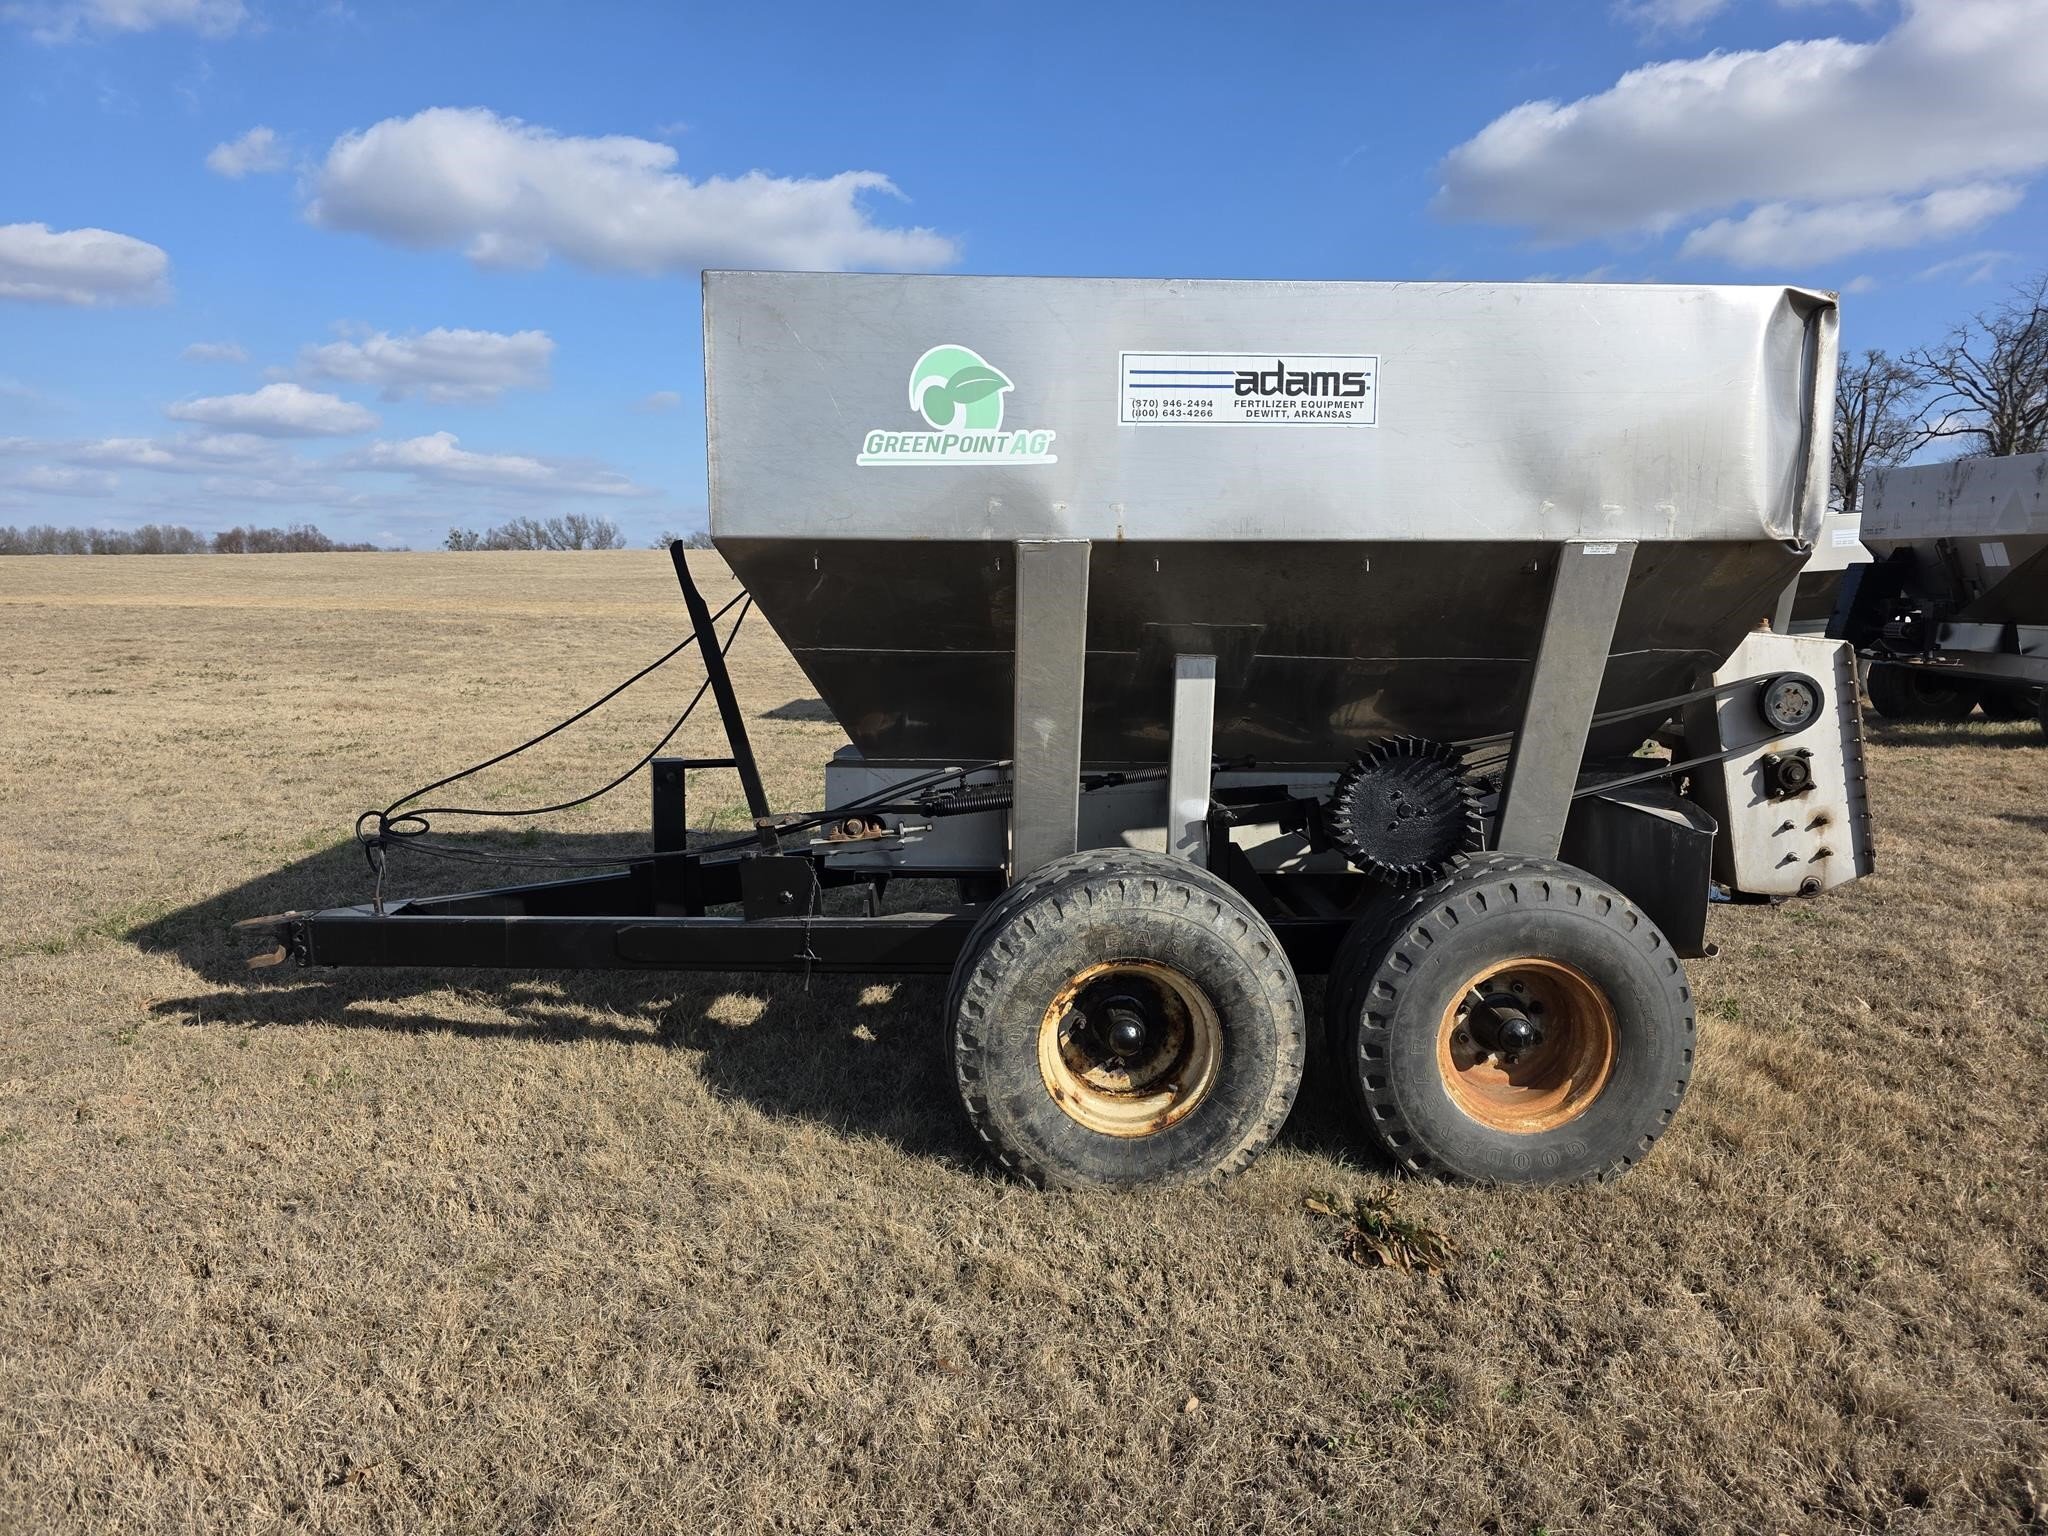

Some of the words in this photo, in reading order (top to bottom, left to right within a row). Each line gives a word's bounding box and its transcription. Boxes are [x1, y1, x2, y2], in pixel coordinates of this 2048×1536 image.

[1234, 359, 1367, 397] adams
[1132, 399, 1159, 408] (870)
[1162, 399, 1214, 408] 946-2494
[1233, 399, 1297, 408] FERTILIZER
[1301, 400, 1365, 409] EQUIPMENT
[1131, 408, 1159, 418] (800)
[1162, 409, 1214, 418] 643-4266
[1246, 409, 1291, 419] DEWITT,
[1294, 409, 1352, 419] ARKANSAS
